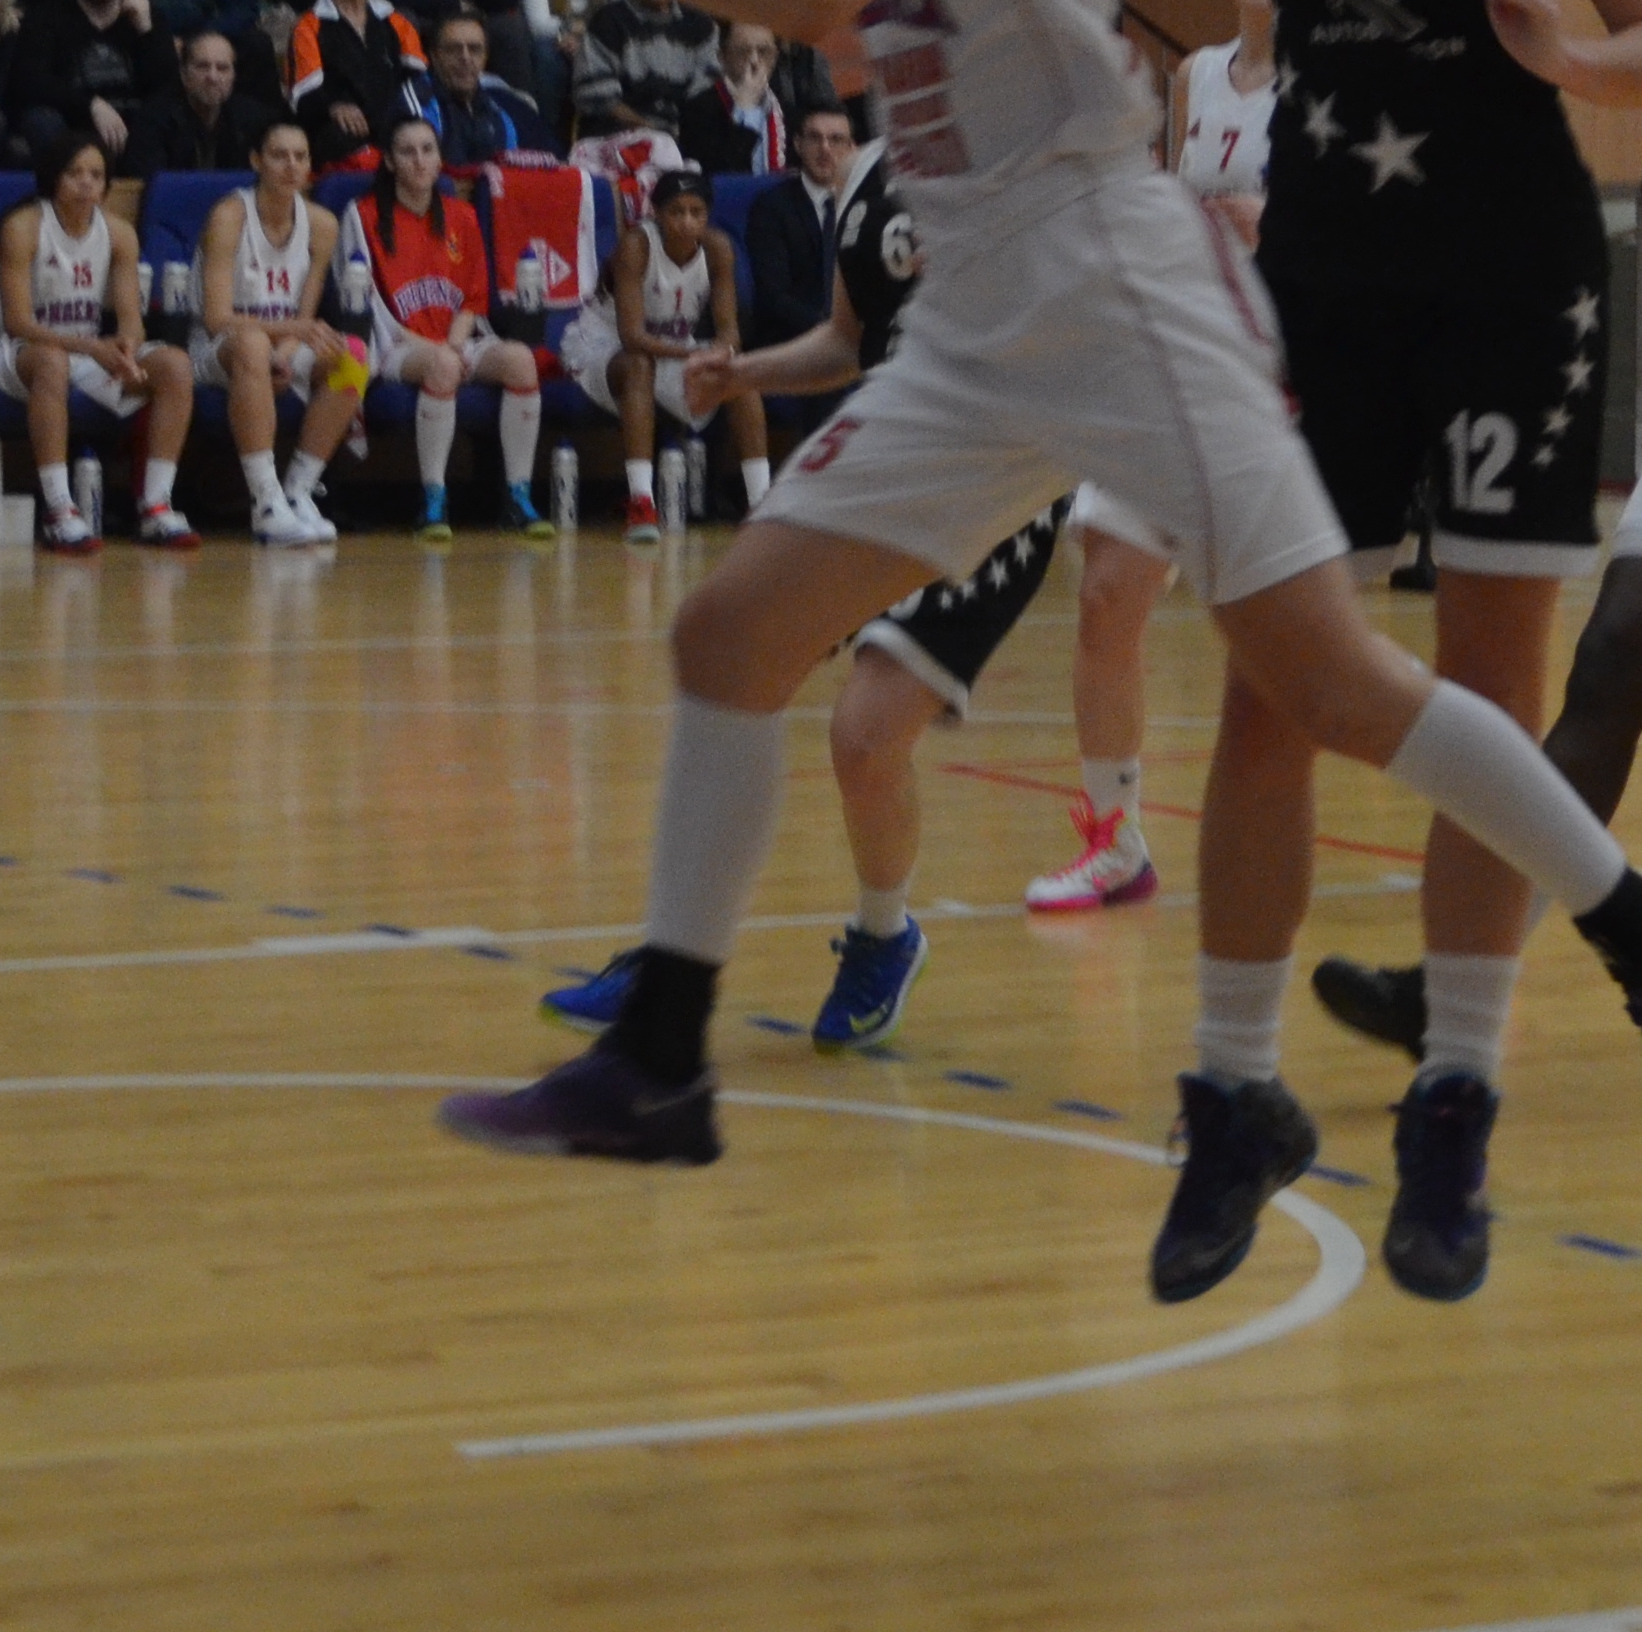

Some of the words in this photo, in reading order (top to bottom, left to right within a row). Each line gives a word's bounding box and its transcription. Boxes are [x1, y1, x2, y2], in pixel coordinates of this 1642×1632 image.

[1219, 130, 1240, 173] 7
[73, 262, 93, 287] 15
[267, 269, 291, 292] 14
[1443, 408, 1519, 515] 12
